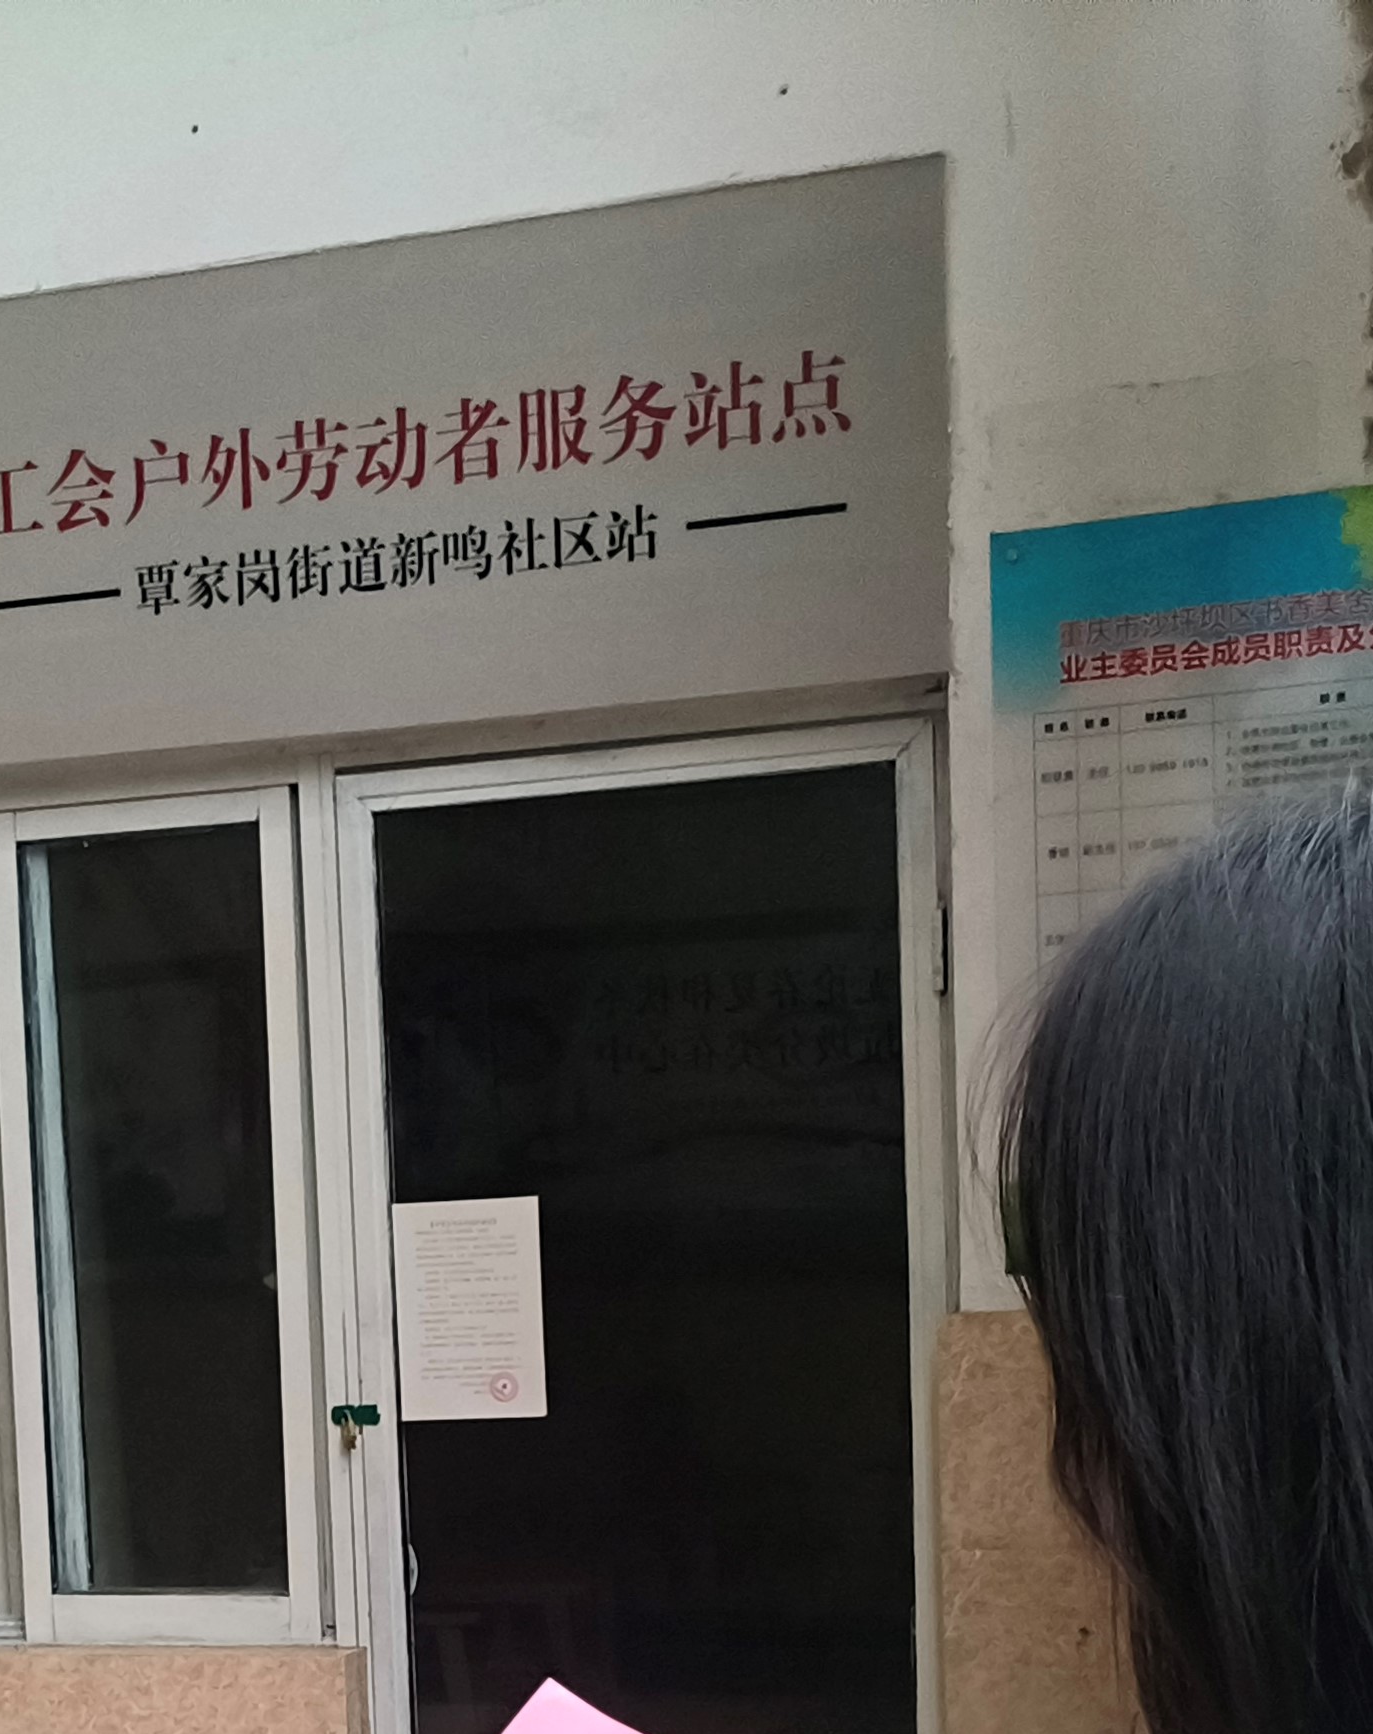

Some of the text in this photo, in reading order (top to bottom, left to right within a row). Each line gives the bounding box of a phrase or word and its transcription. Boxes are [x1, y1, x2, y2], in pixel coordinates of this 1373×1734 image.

[135, 504, 659, 616] 覃家岗街道新鸣社区站
